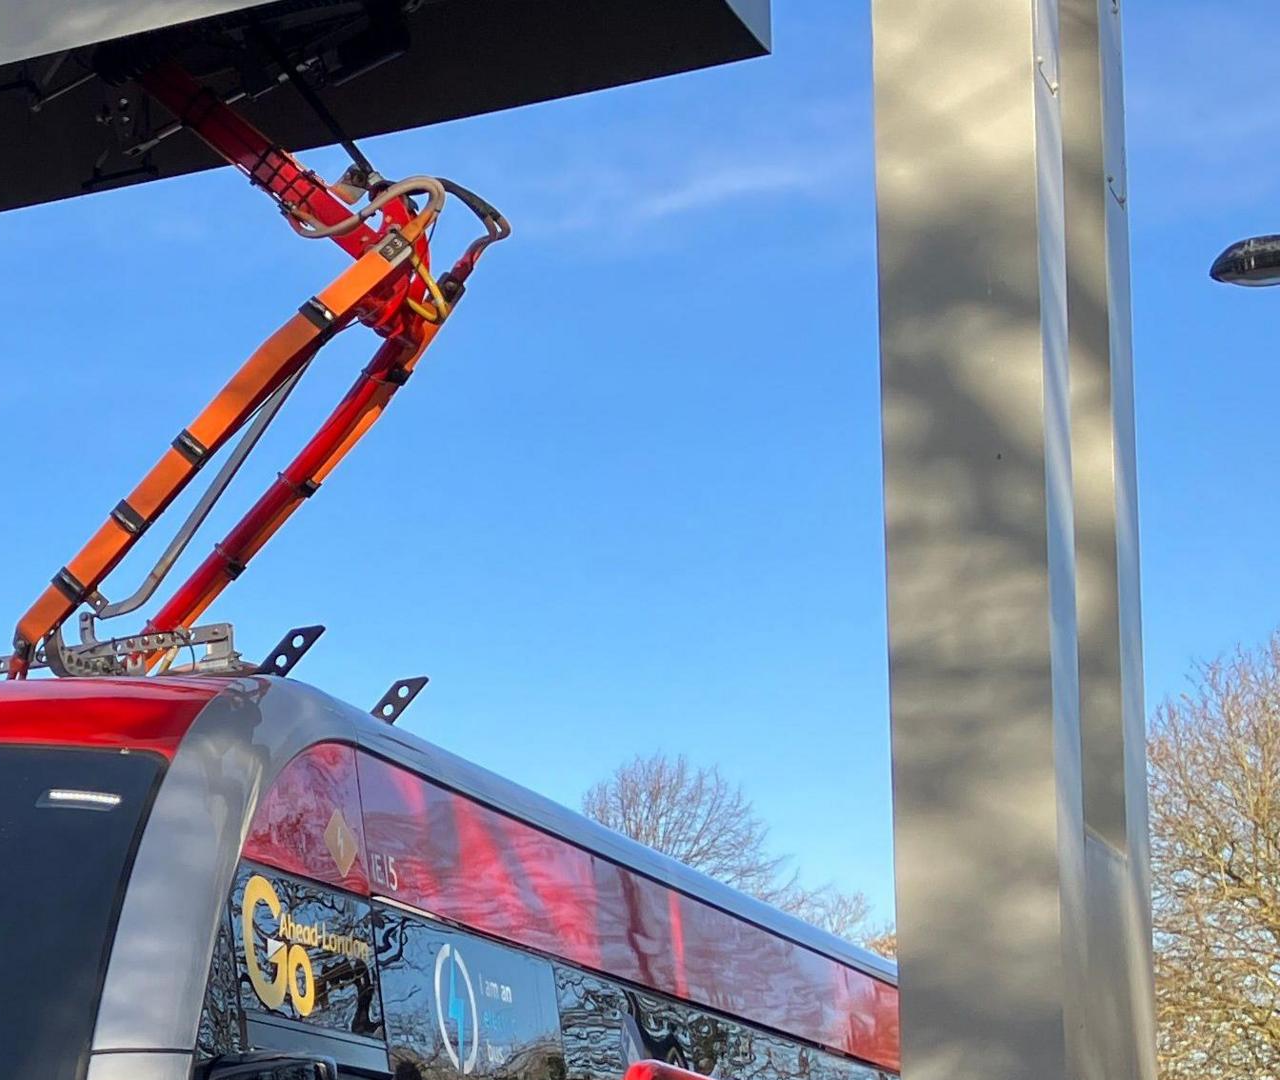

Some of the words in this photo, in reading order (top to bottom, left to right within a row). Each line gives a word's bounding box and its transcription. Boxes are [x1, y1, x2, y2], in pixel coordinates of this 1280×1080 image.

[243, 875, 315, 1017] Go
[279, 913, 369, 960] Ahead-London
[500, 984, 513, 1003] an
